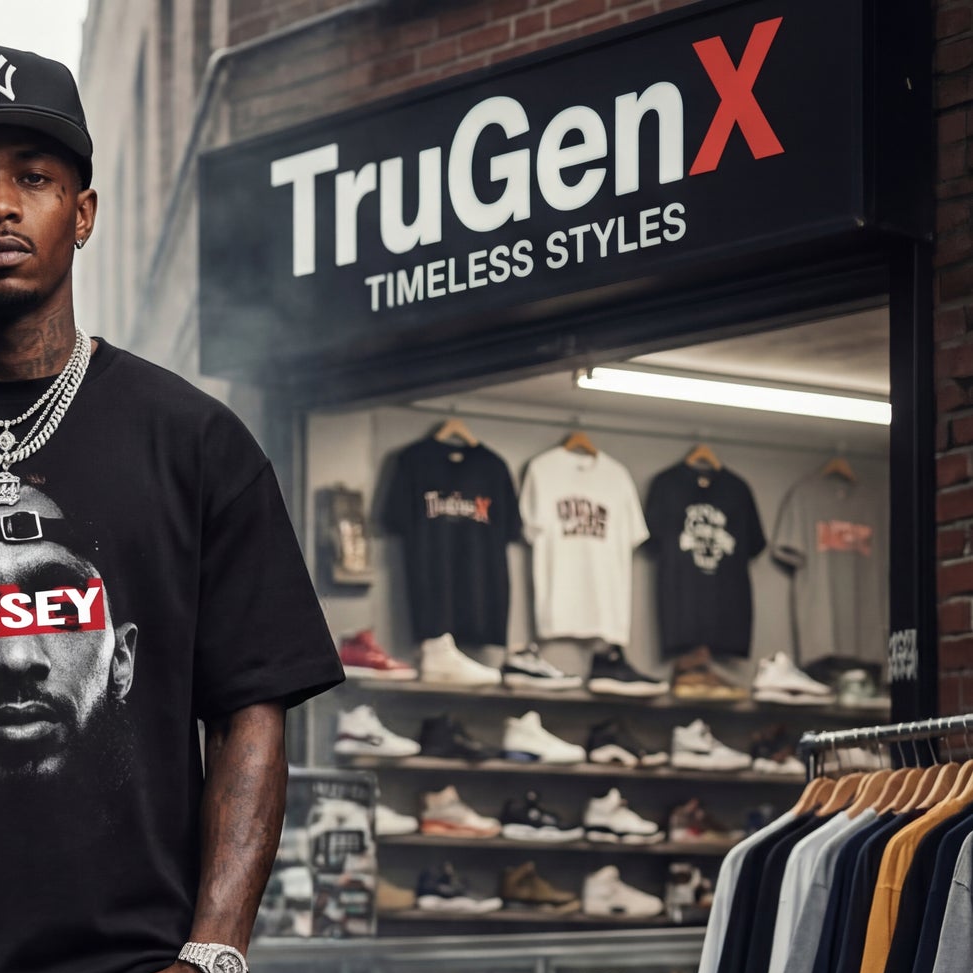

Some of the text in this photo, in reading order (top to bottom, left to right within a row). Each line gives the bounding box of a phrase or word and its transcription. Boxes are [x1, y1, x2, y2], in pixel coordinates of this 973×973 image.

[270, 16, 785, 277] TruGenX
[365, 203, 687, 311] TIMELESS STYLES
